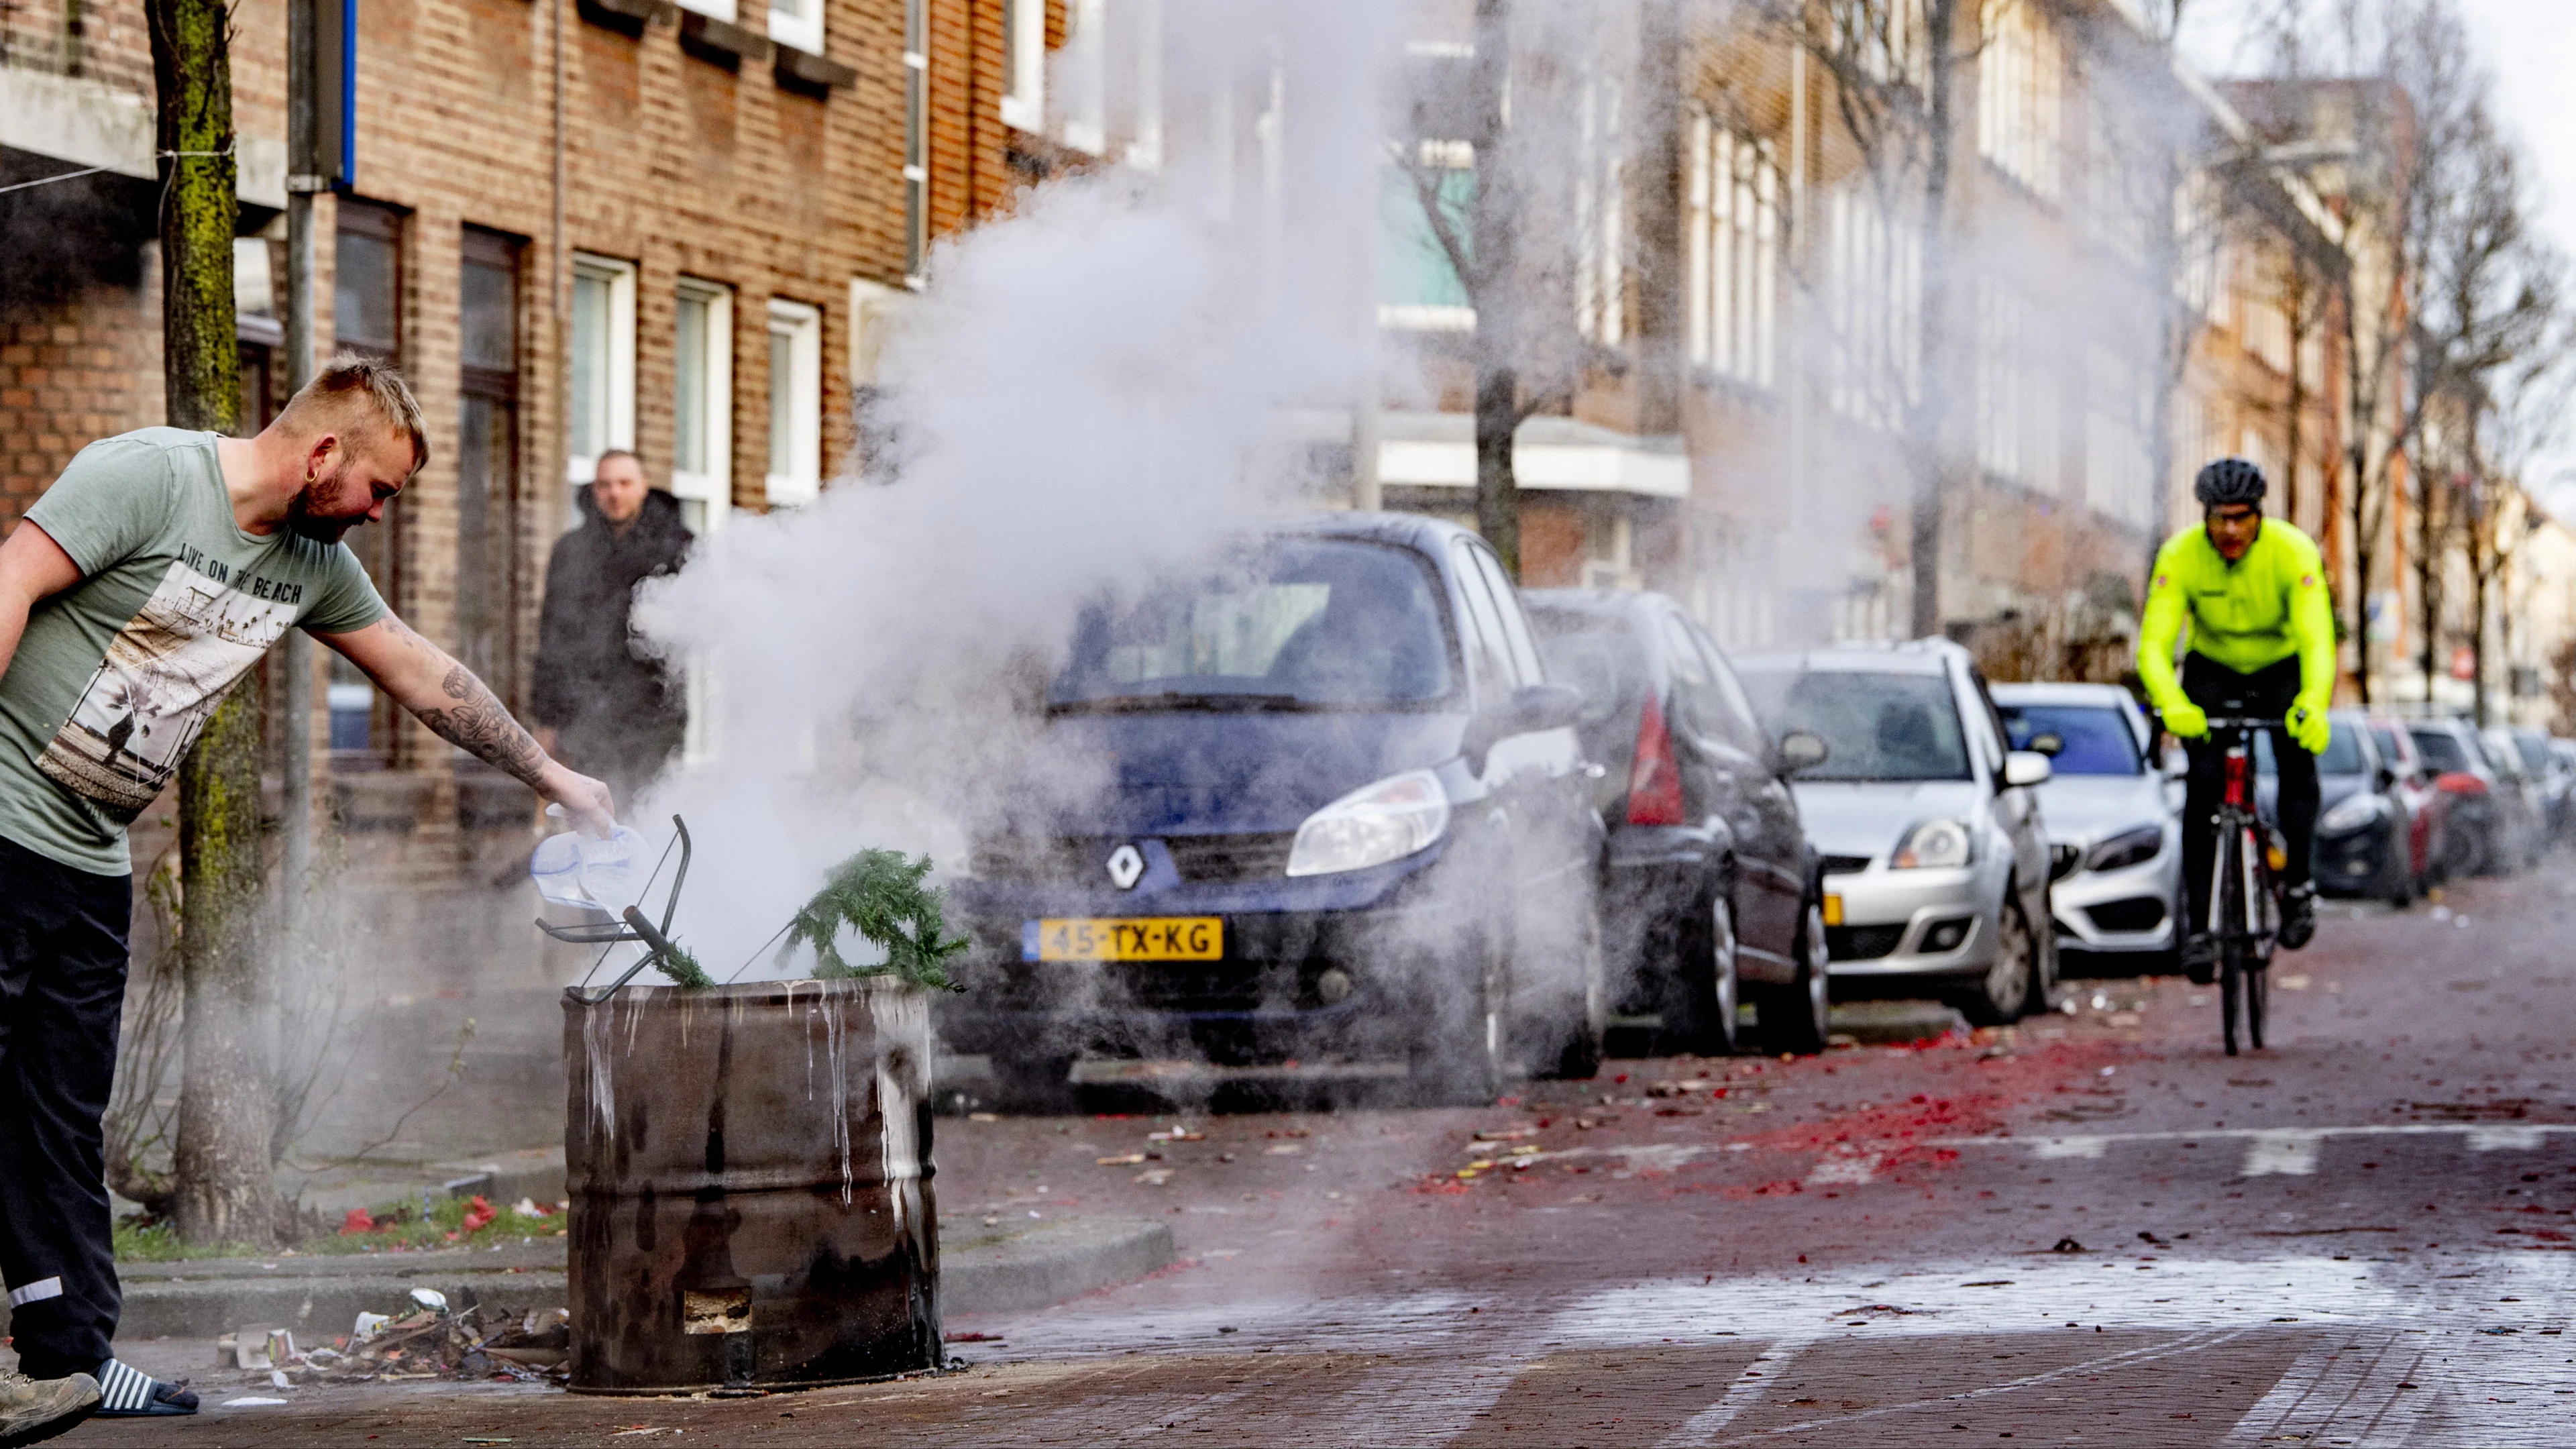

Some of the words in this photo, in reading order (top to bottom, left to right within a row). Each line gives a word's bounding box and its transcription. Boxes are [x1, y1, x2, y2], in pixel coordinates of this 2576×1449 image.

[178, 542, 204, 572] LIVE
[209, 559, 228, 583] ON
[252, 576, 302, 604] BEACH
[1051, 923, 1210, 954] 45-TX-KG
